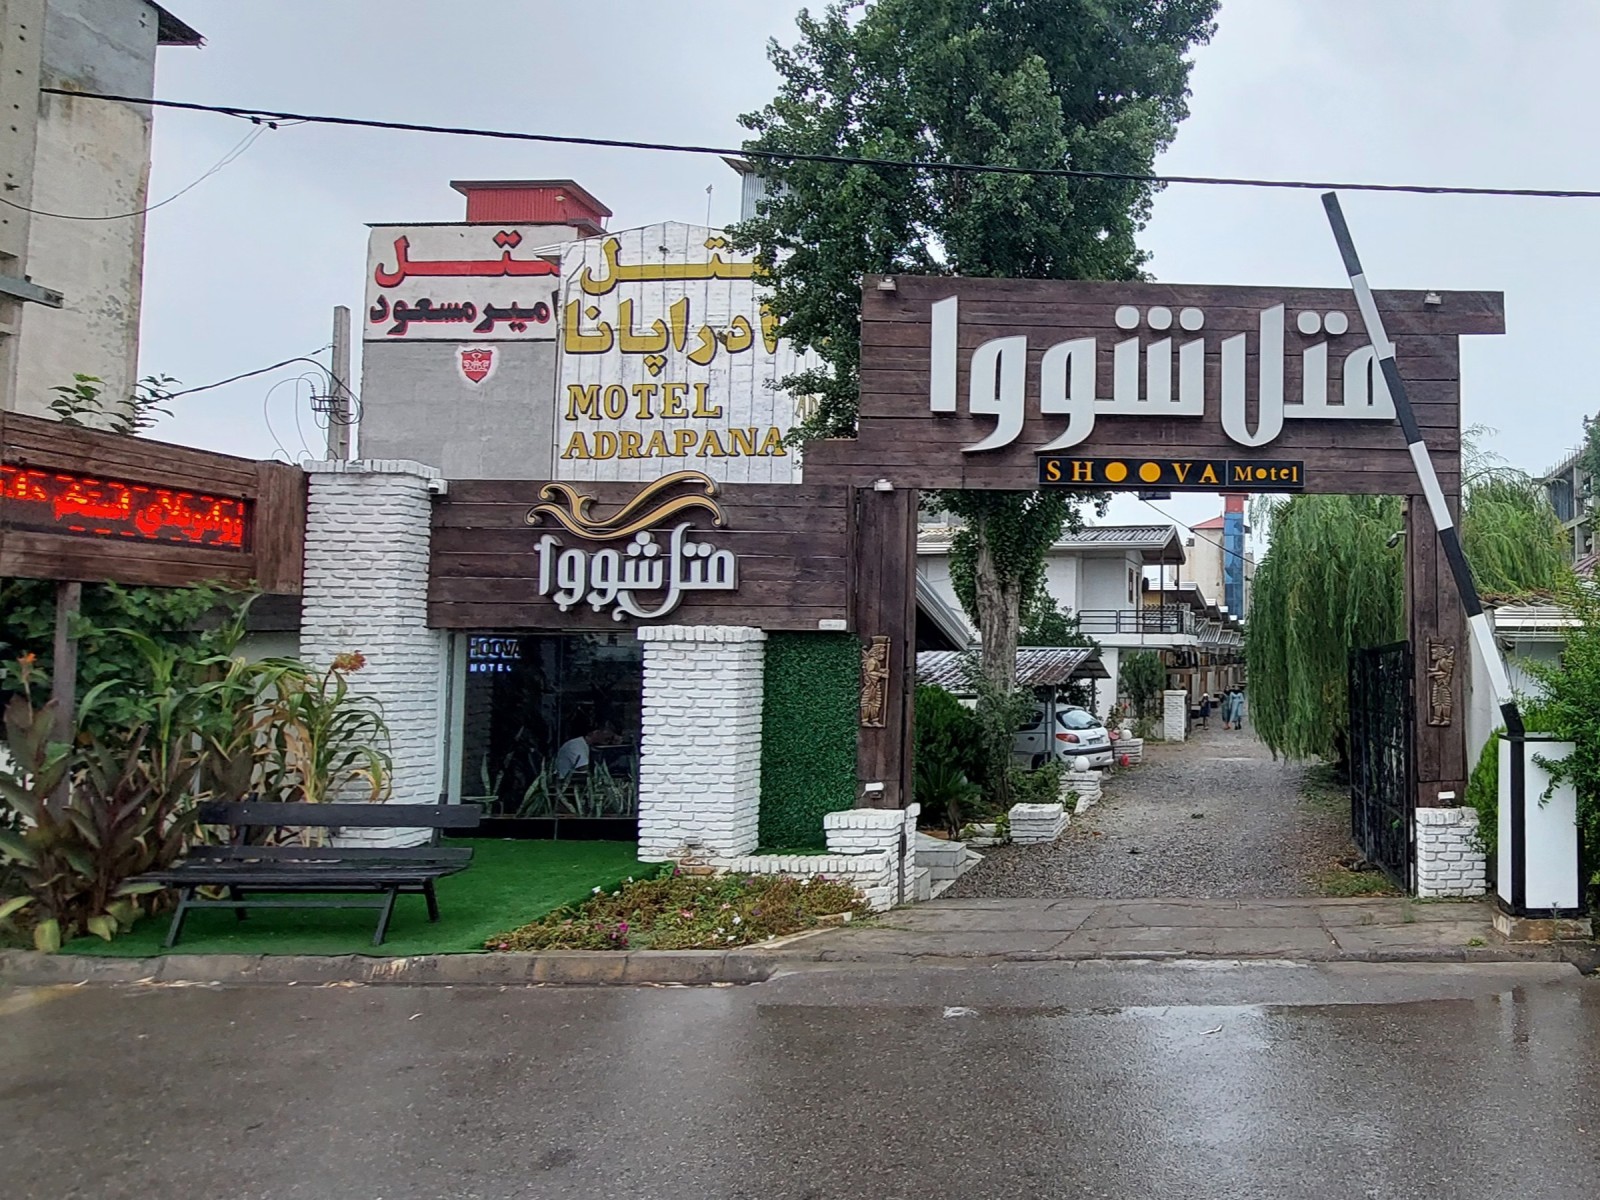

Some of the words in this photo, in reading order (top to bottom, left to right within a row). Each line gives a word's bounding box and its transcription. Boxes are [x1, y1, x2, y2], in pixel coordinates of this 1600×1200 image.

[565, 383, 723, 420] MOTEL
[930, 294, 1205, 453] شووا
[1220, 303, 1398, 447] متل
[561, 426, 787, 460] ADRAPANA
[1046, 460, 1219, 484] SHOOVA
[1234, 465, 1298, 483] Motel
[533, 530, 668, 613] شووا
[612, 522, 739, 621] متل
